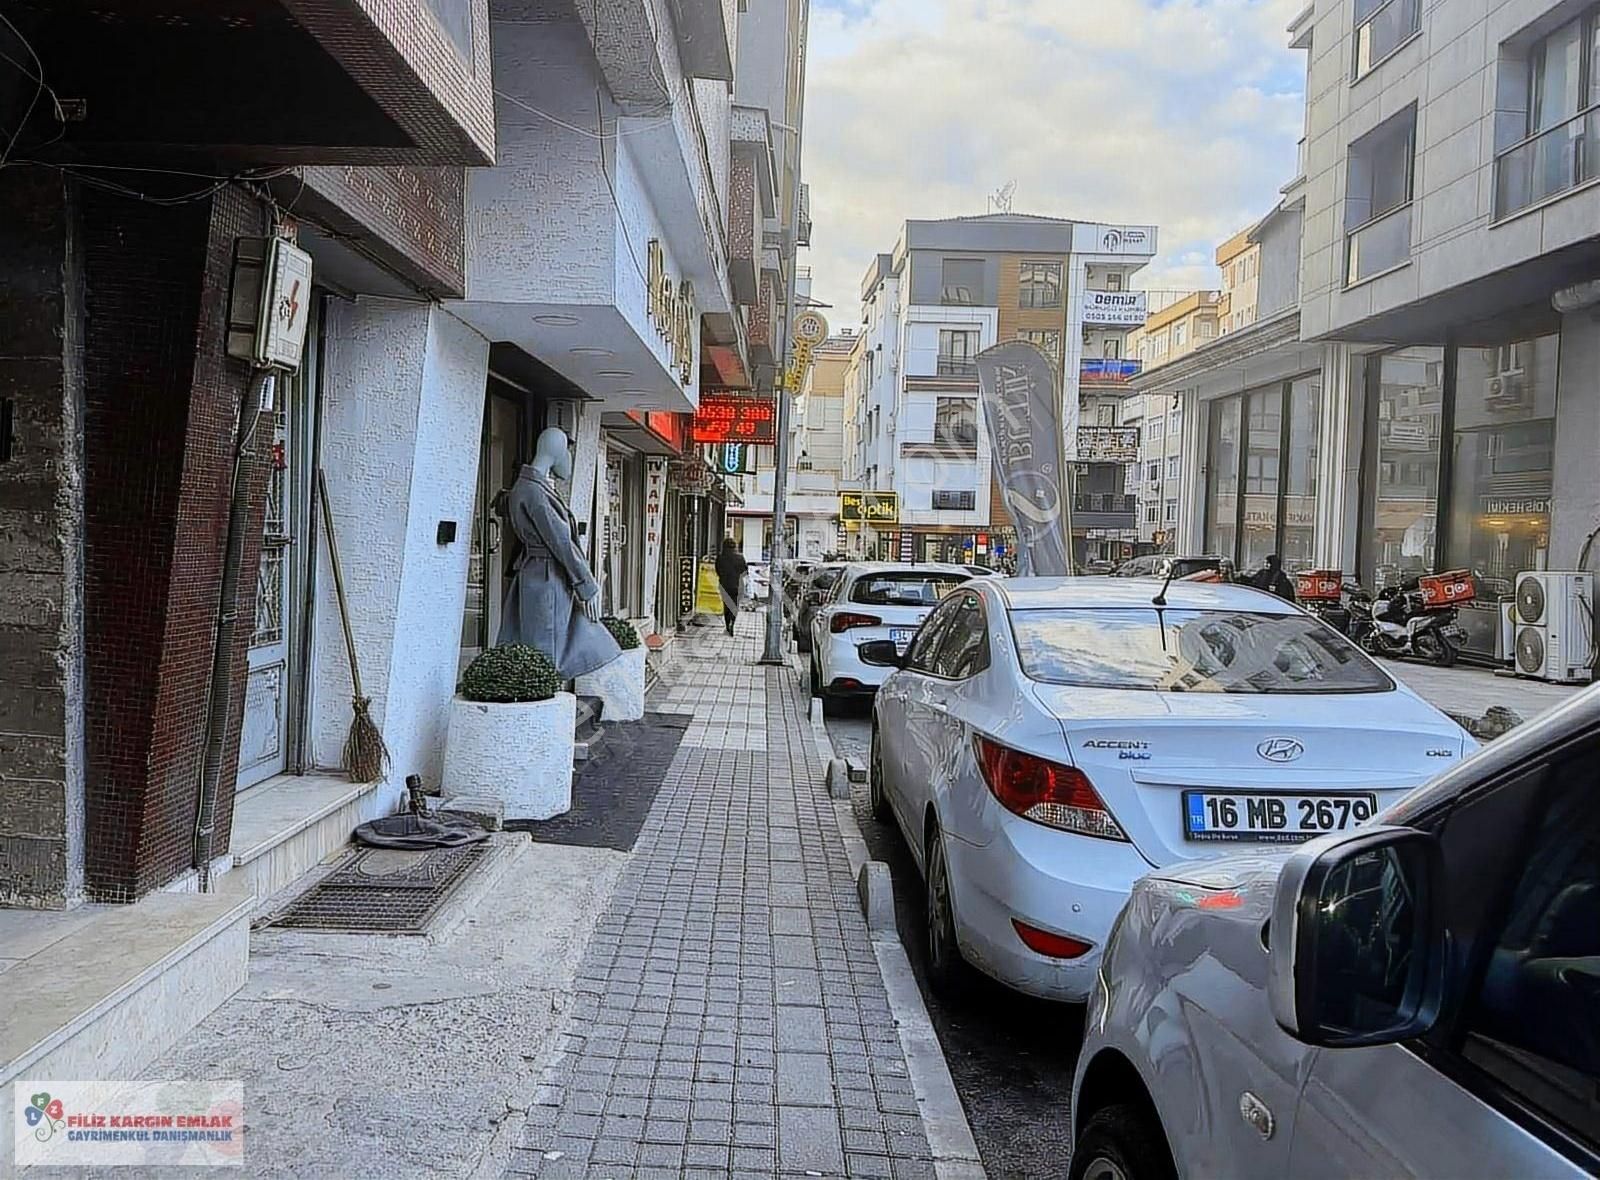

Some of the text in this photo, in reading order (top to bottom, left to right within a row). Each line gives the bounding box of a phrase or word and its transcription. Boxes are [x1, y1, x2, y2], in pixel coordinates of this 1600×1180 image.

[647, 461, 662, 471] TV
[857, 501, 894, 518] optik
[1082, 740, 1152, 749] ACCENT
[1206, 798, 1371, 830] 16 MB 2679
[1191, 815, 1204, 824] TR
